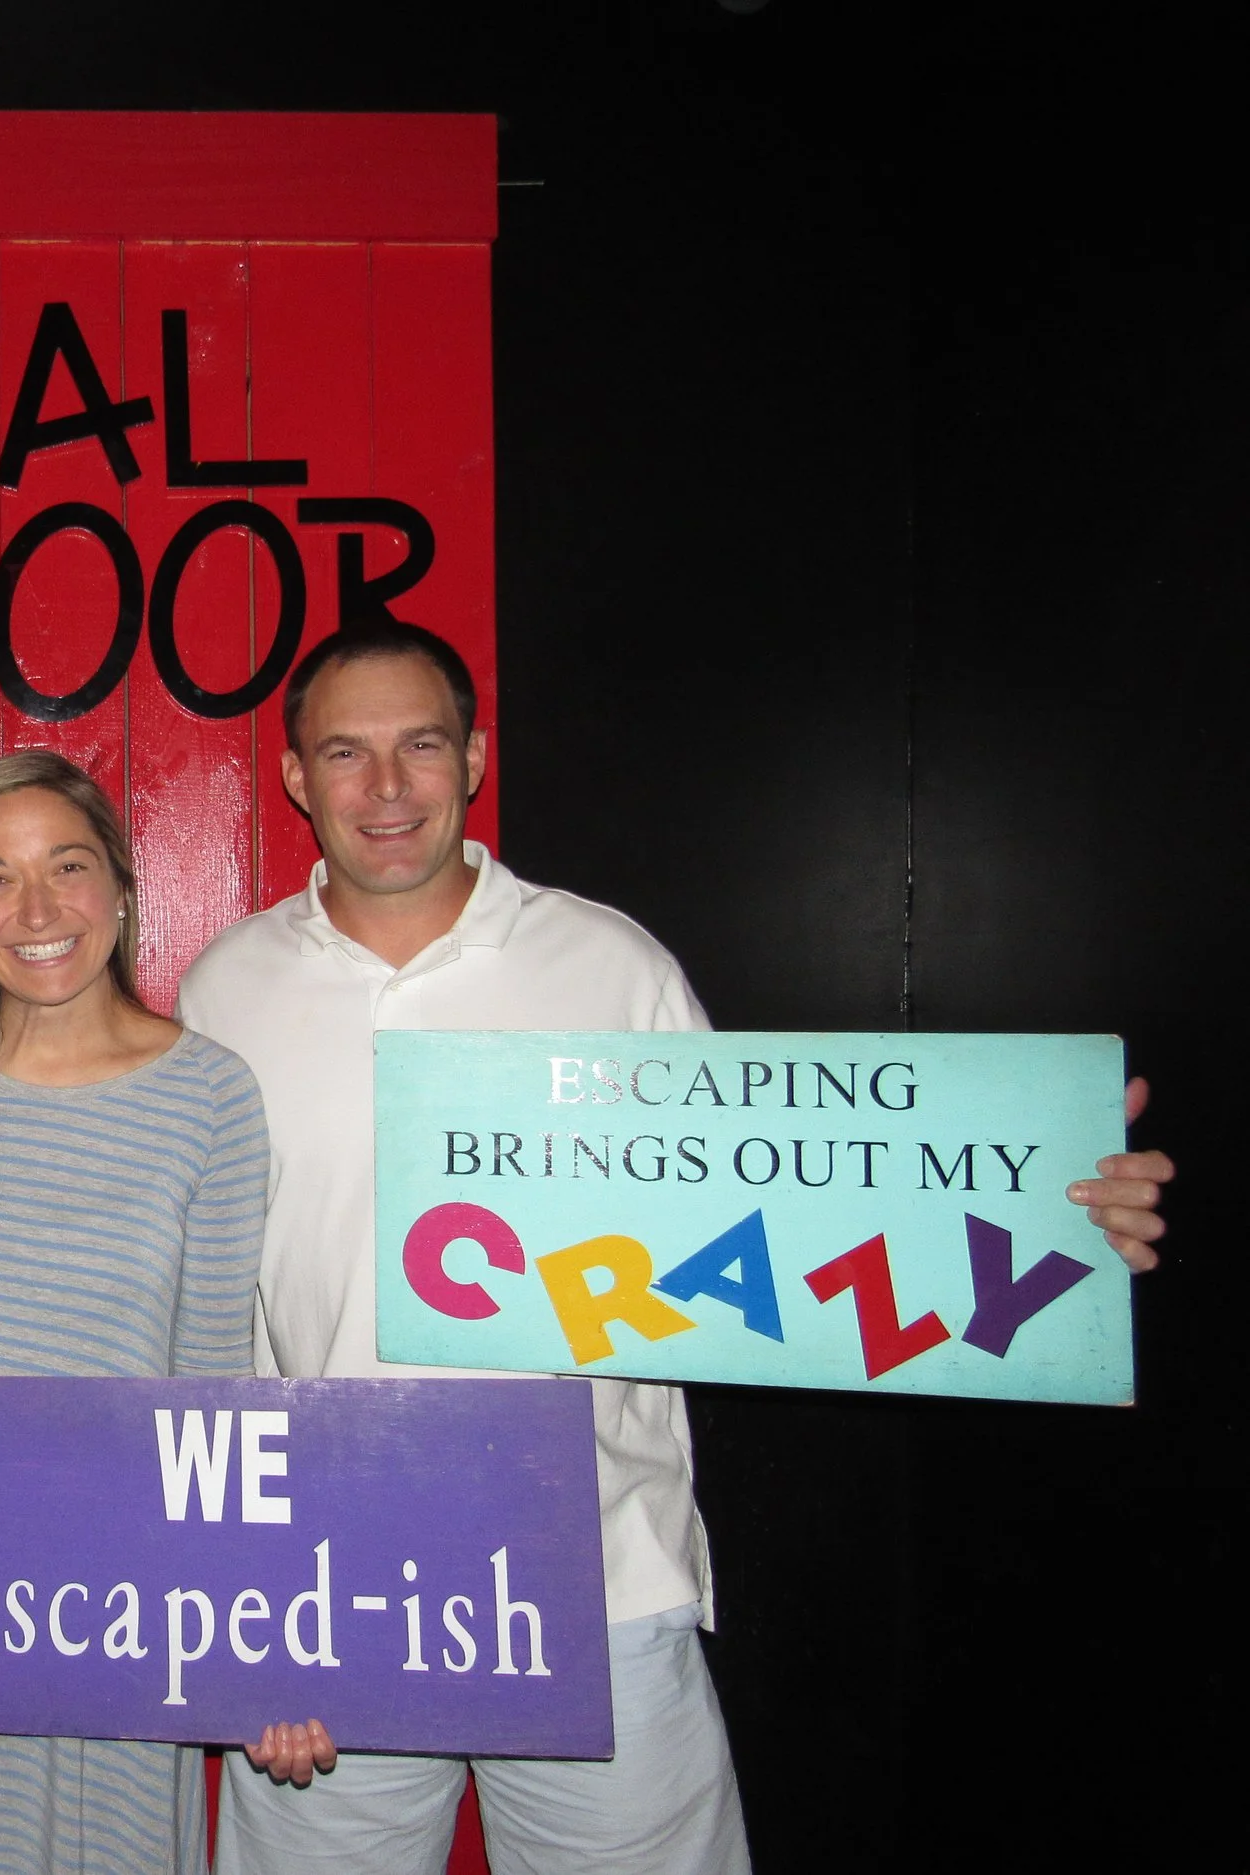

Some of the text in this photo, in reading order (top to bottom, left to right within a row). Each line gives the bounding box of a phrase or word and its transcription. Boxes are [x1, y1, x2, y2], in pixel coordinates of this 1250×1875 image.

[547, 1057, 920, 1112] ESCAPING
[443, 1130, 1041, 1193] BRINGS OUT MY
[402, 1201, 1096, 1382] CRAZY
[154, 1408, 292, 1524] WE
